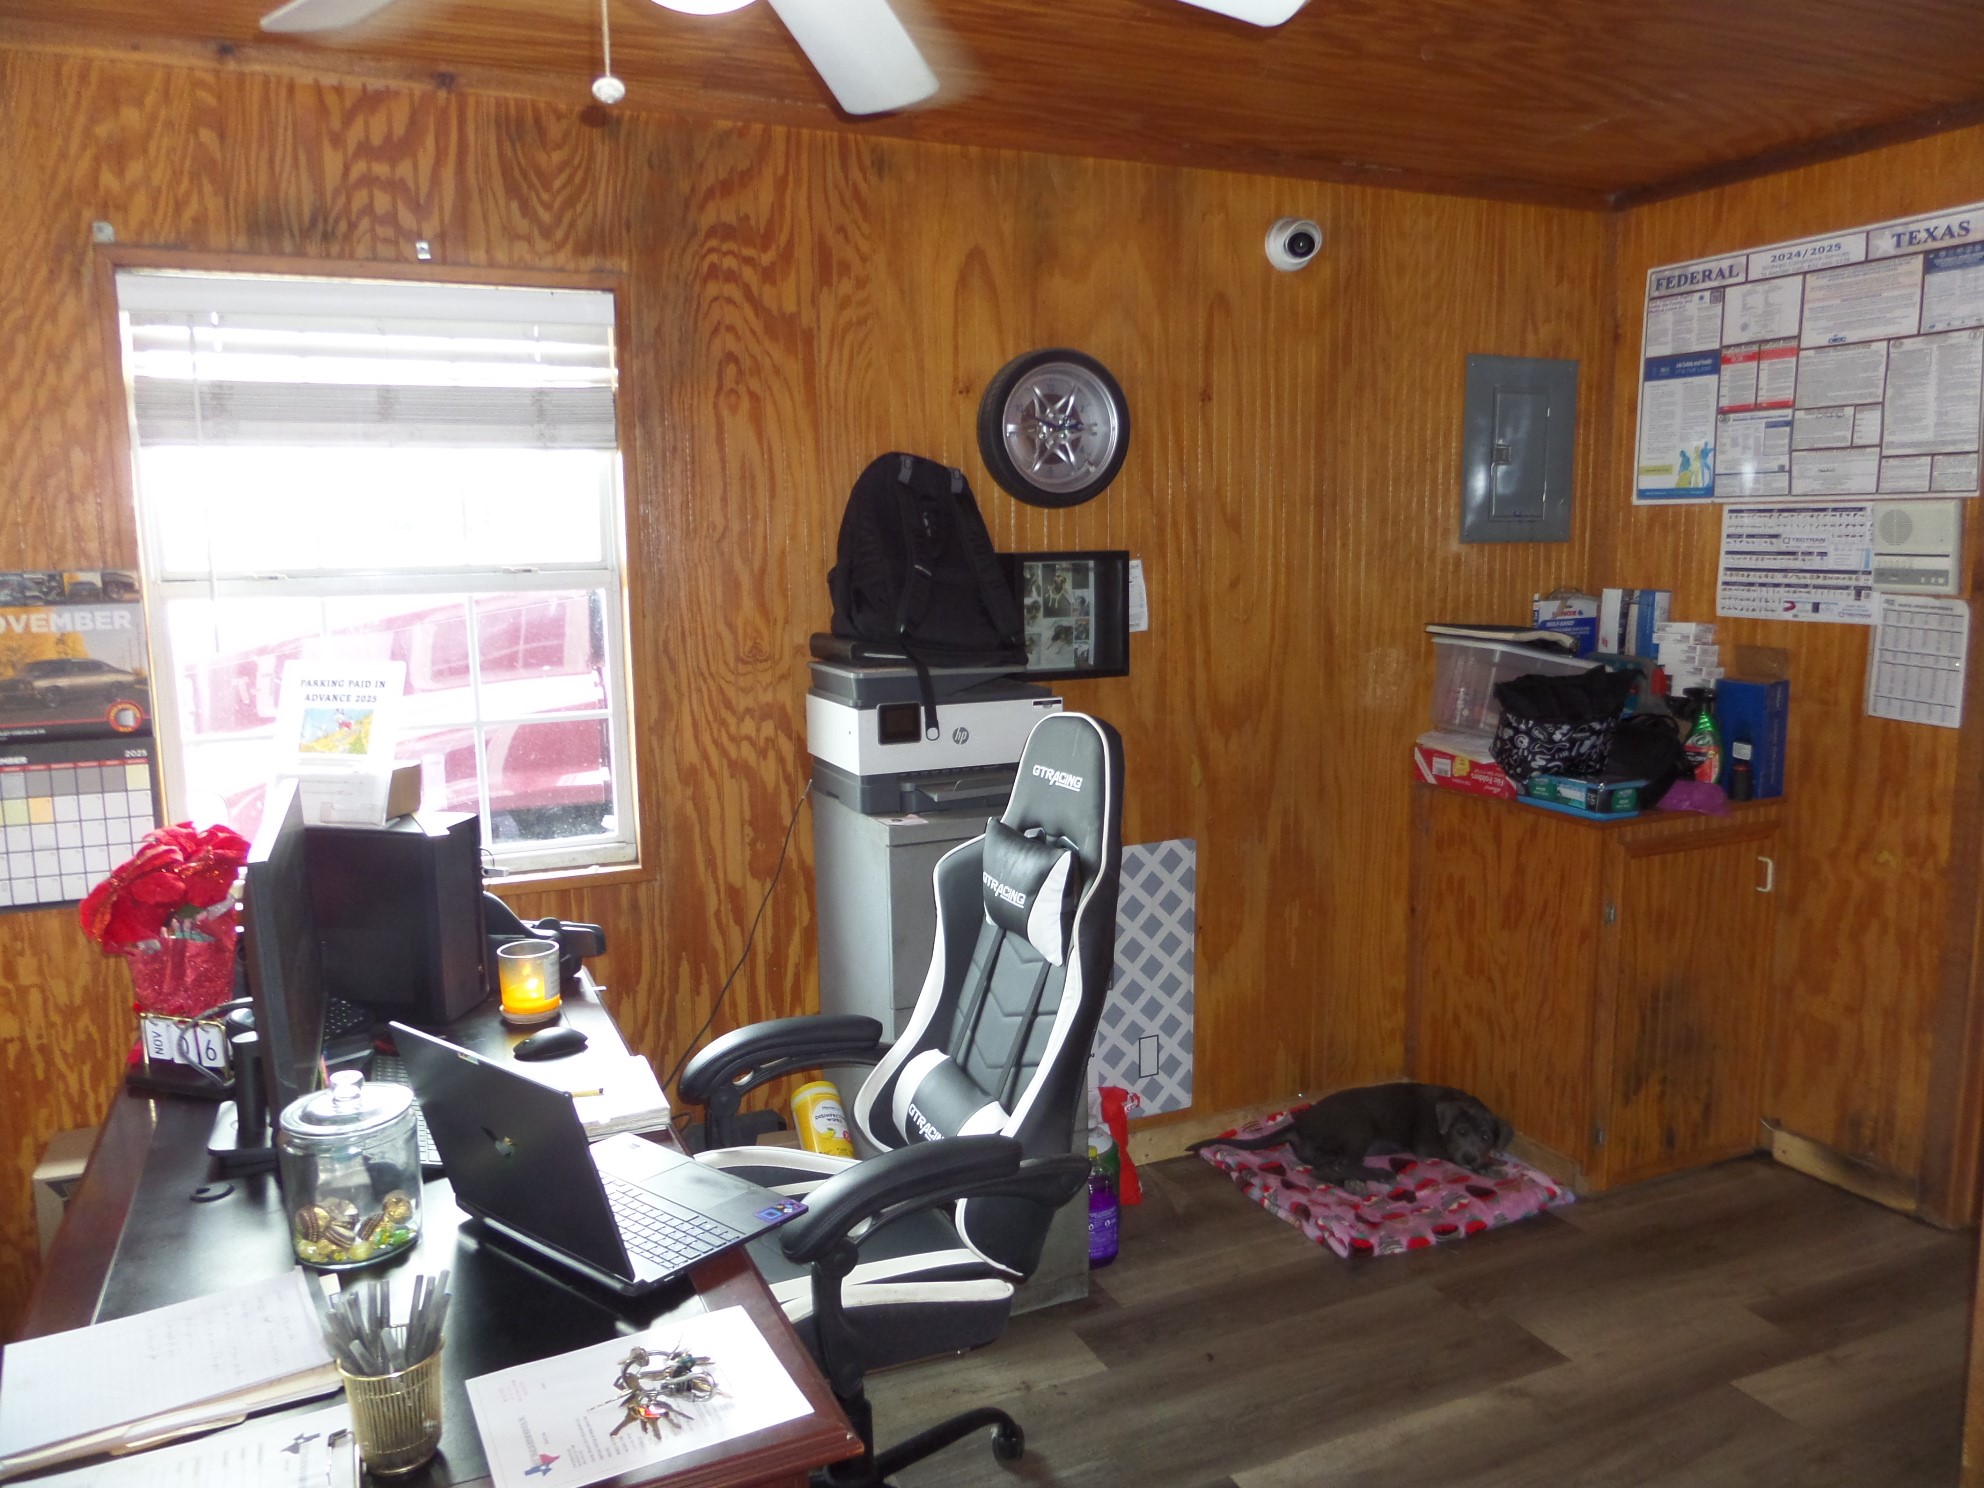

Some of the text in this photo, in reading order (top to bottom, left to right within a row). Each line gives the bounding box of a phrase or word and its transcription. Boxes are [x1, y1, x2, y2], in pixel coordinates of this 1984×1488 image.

[1891, 220, 1971, 248] TEXAS
[1770, 243, 1842, 263] 2024/2025
[1655, 264, 1740, 291] FEDERAL
[300, 679, 386, 688] PARKING PAID IN
[305, 694, 378, 703] ADVANCE 2025
[954, 727, 969, 745] hp
[1032, 764, 1083, 791] GTRACING
[152, 1030, 165, 1055] NOV
[205, 1039, 217, 1061] 6
